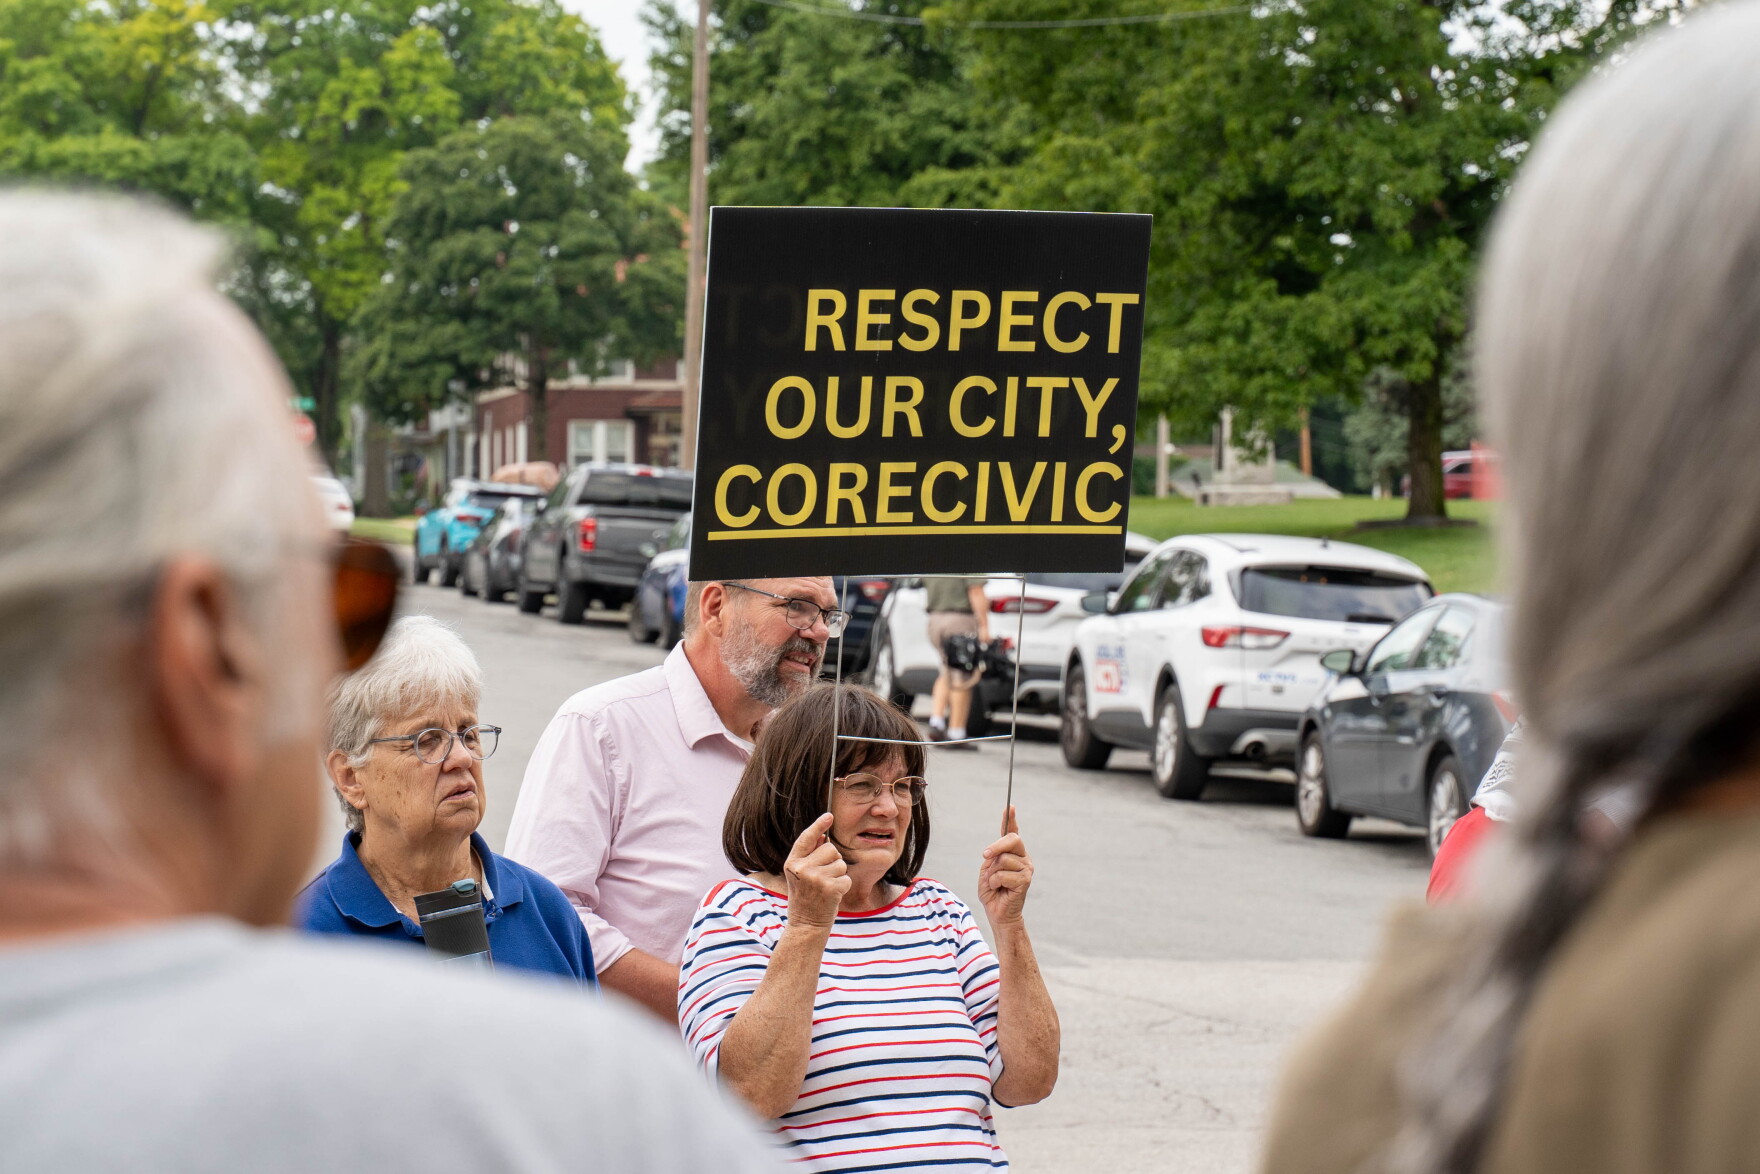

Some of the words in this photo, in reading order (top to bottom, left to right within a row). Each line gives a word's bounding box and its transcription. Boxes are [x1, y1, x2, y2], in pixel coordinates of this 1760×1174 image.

[804, 288, 1140, 354] RESPECT
[764, 375, 925, 440] OUR
[949, 375, 1127, 455] CITY,
[714, 460, 1124, 529] CORECIVIC
